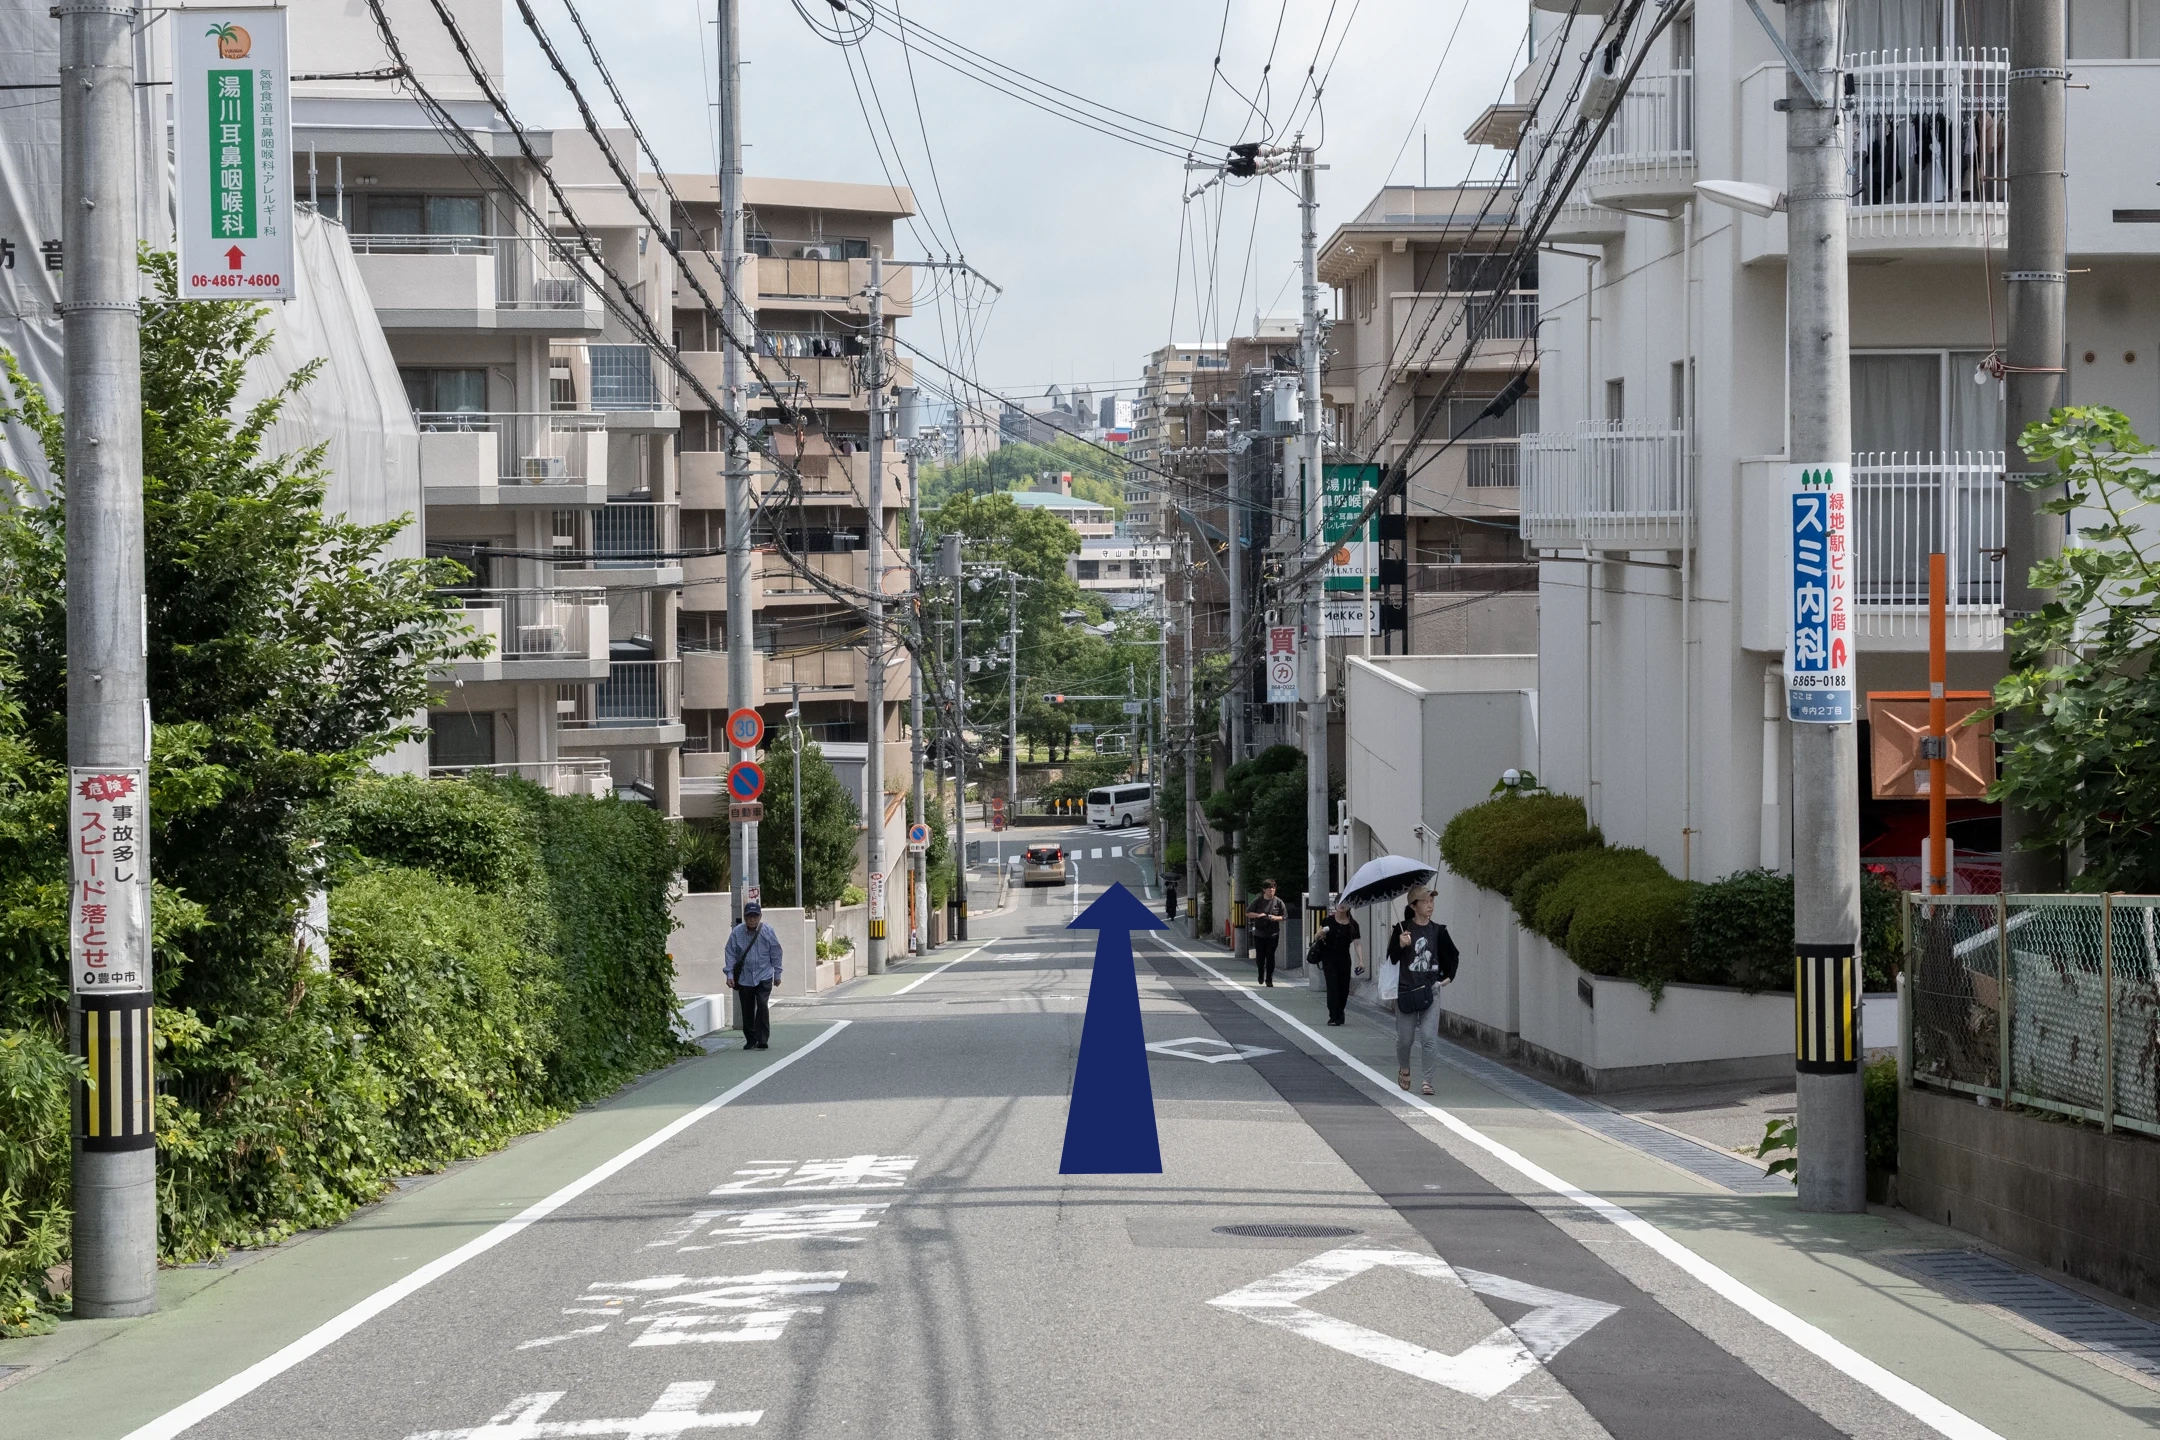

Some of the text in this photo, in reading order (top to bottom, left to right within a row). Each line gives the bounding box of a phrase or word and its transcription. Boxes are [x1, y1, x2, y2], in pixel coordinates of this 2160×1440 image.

[218, 75, 245, 237] 湯川耳鼻咽喉科
[191, 274, 280, 287] 06-4867-4600
[1796, 497, 1827, 669] スミ内科
[1269, 628, 1296, 655] 質
[1792, 675, 1846, 687] 6865-0188
[1792, 692, 1812, 701] ここは
[735, 719, 756, 738] 30
[87, 779, 123, 796] 危険
[731, 807, 762, 818] 自動車
[112, 805, 134, 883] 事故多し
[80, 812, 109, 969] スピード落とせ
[97, 971, 136, 984] 豊中市
